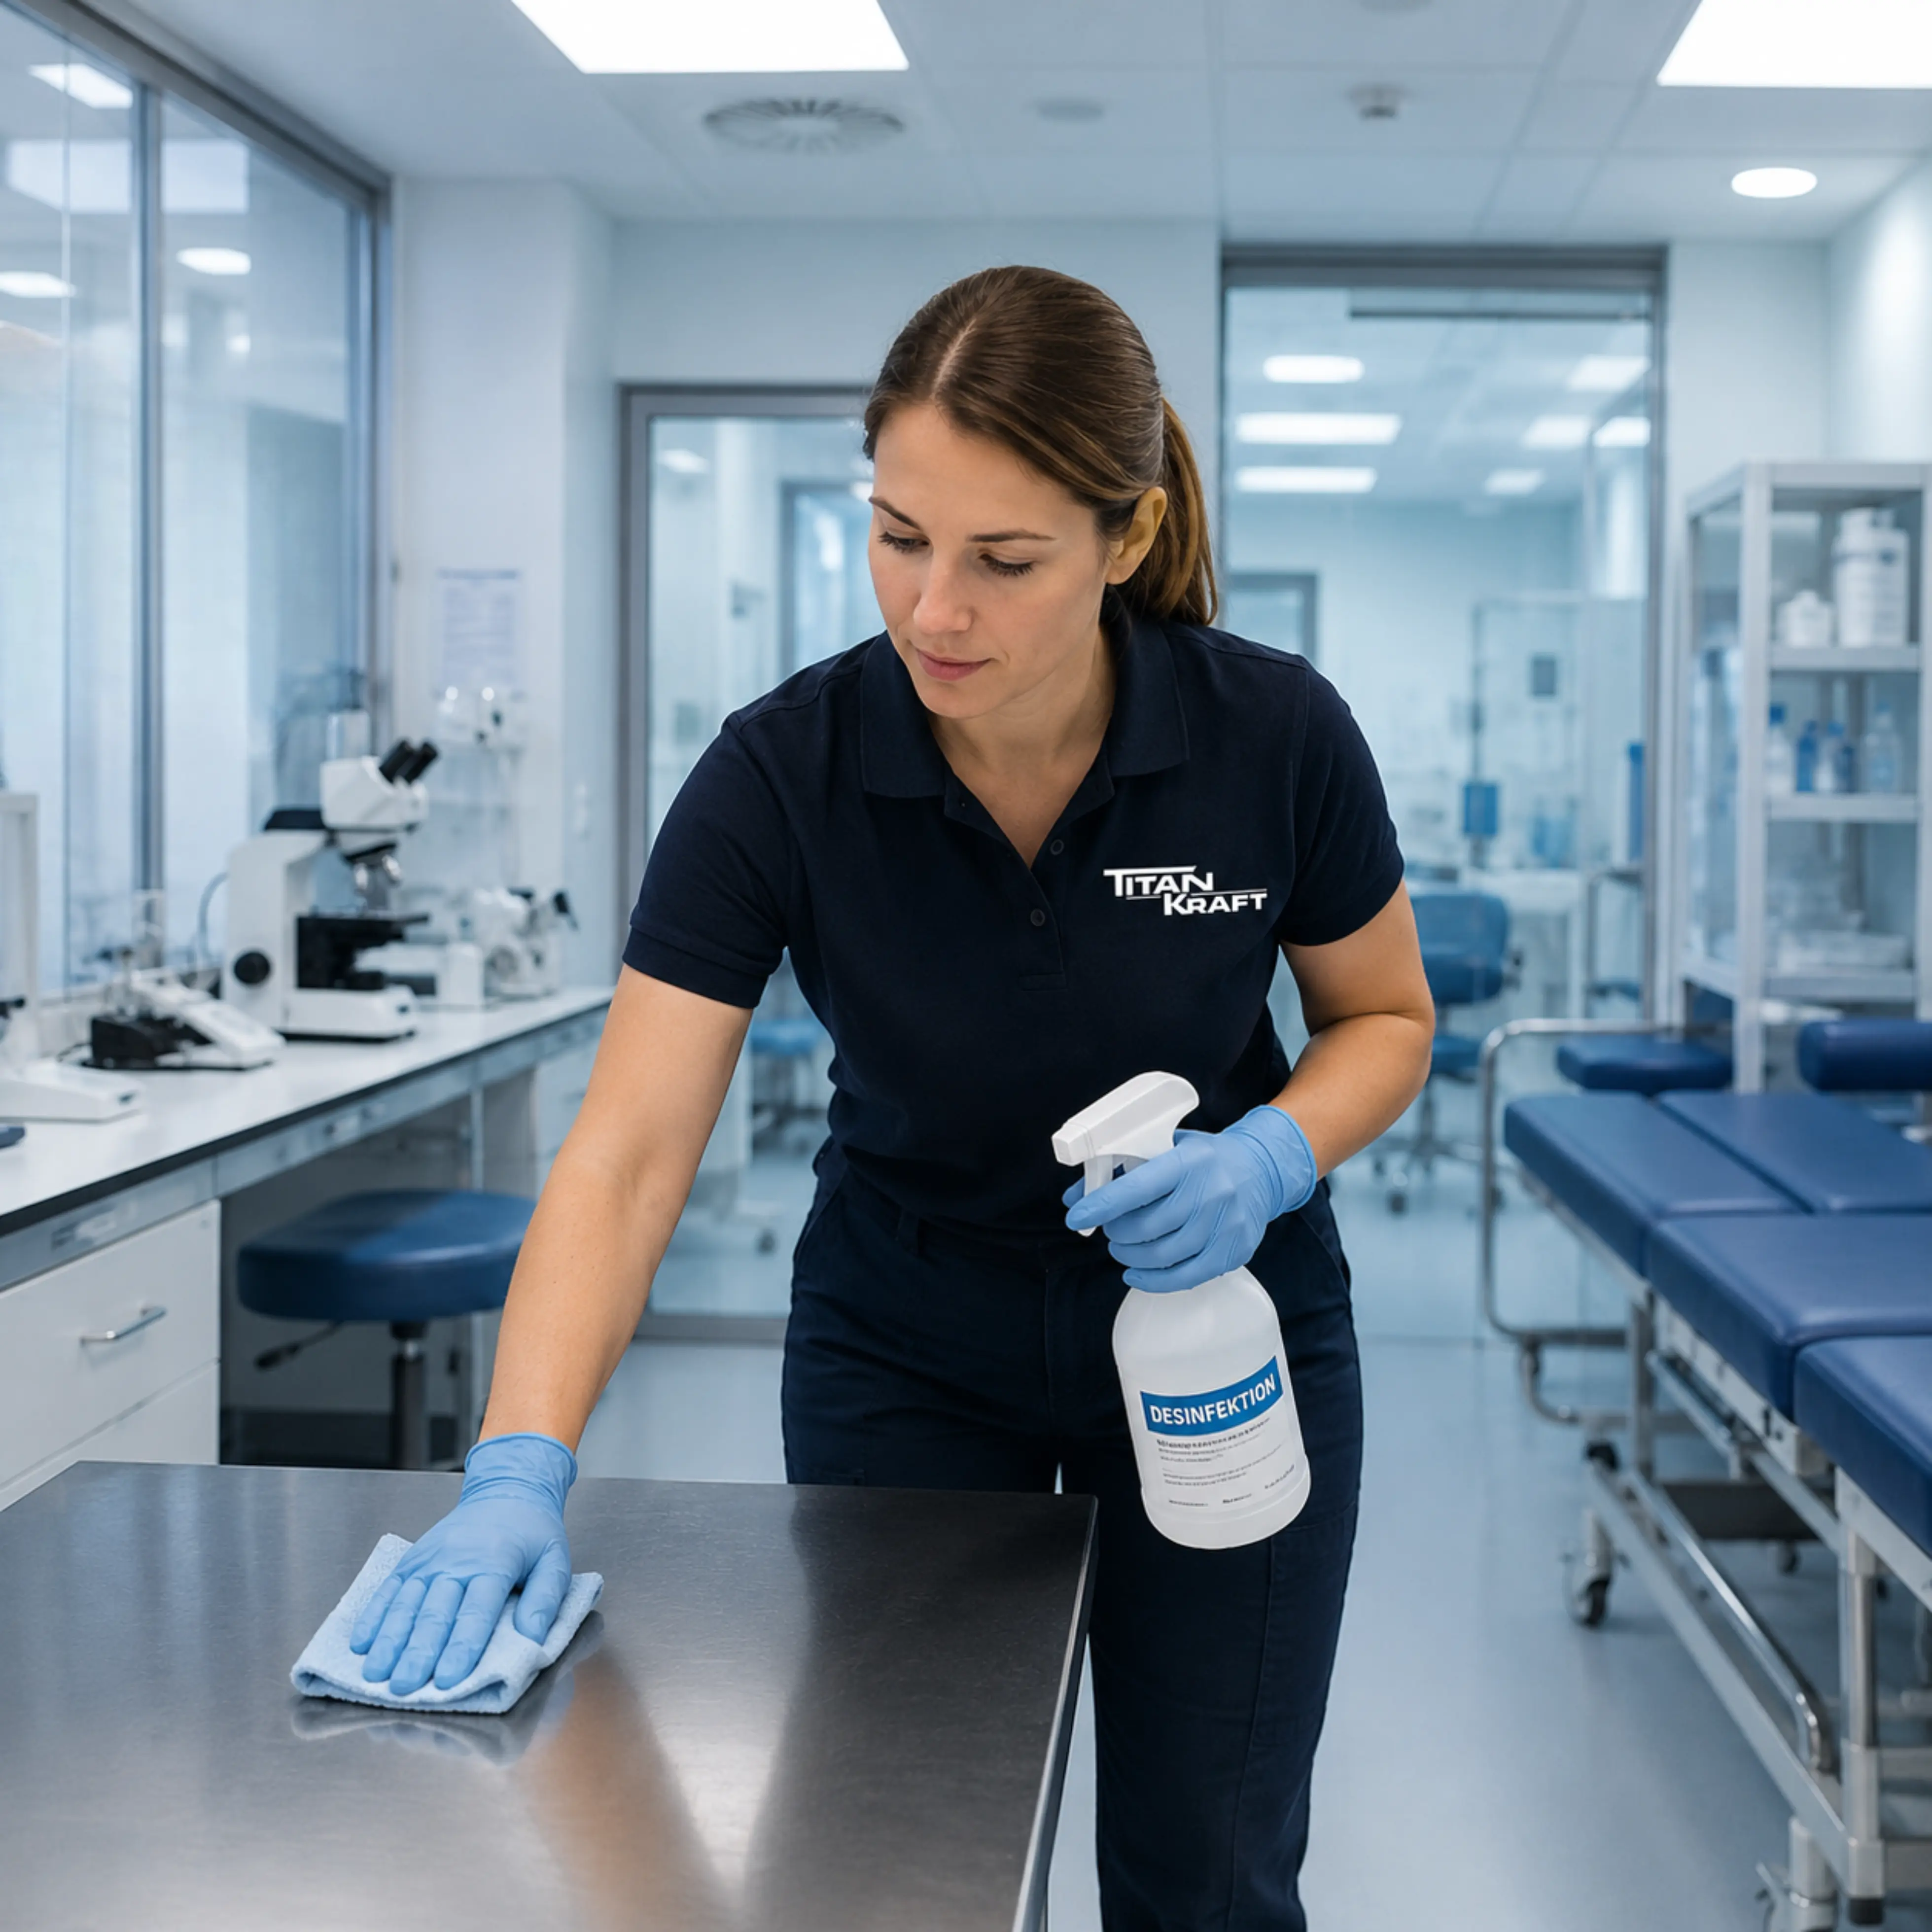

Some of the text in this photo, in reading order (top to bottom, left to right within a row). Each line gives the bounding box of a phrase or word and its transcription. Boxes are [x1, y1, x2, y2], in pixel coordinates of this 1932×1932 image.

[1103, 865, 1214, 897] TITAN
[1164, 893, 1267, 916] KRAFT
[1149, 1372, 1276, 1425] DESINFEKTION
